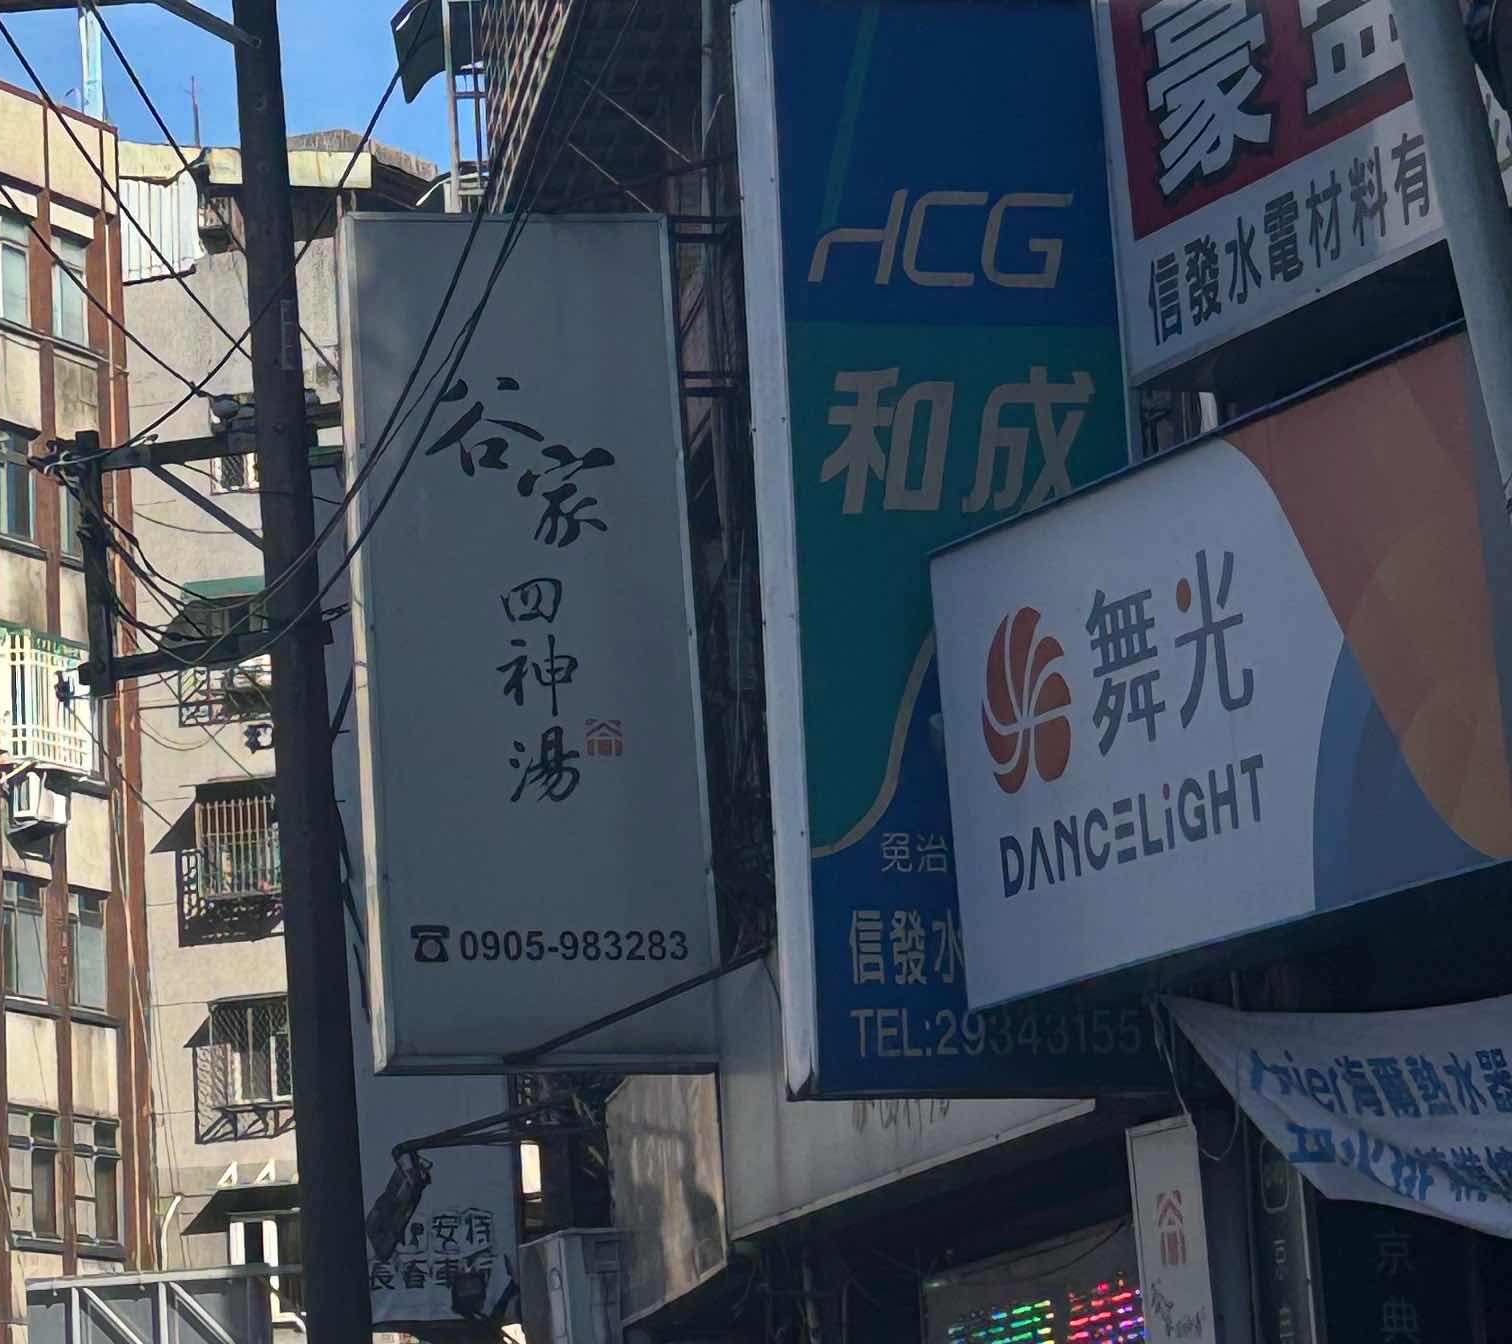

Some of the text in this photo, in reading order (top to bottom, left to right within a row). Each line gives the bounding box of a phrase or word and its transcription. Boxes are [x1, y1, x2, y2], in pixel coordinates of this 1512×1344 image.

[807, 188, 1074, 289] HCG
[819, 365, 1097, 514] 和成
[1085, 548, 1255, 758] 舞光
[459, 930, 689, 964] 0905-983283
